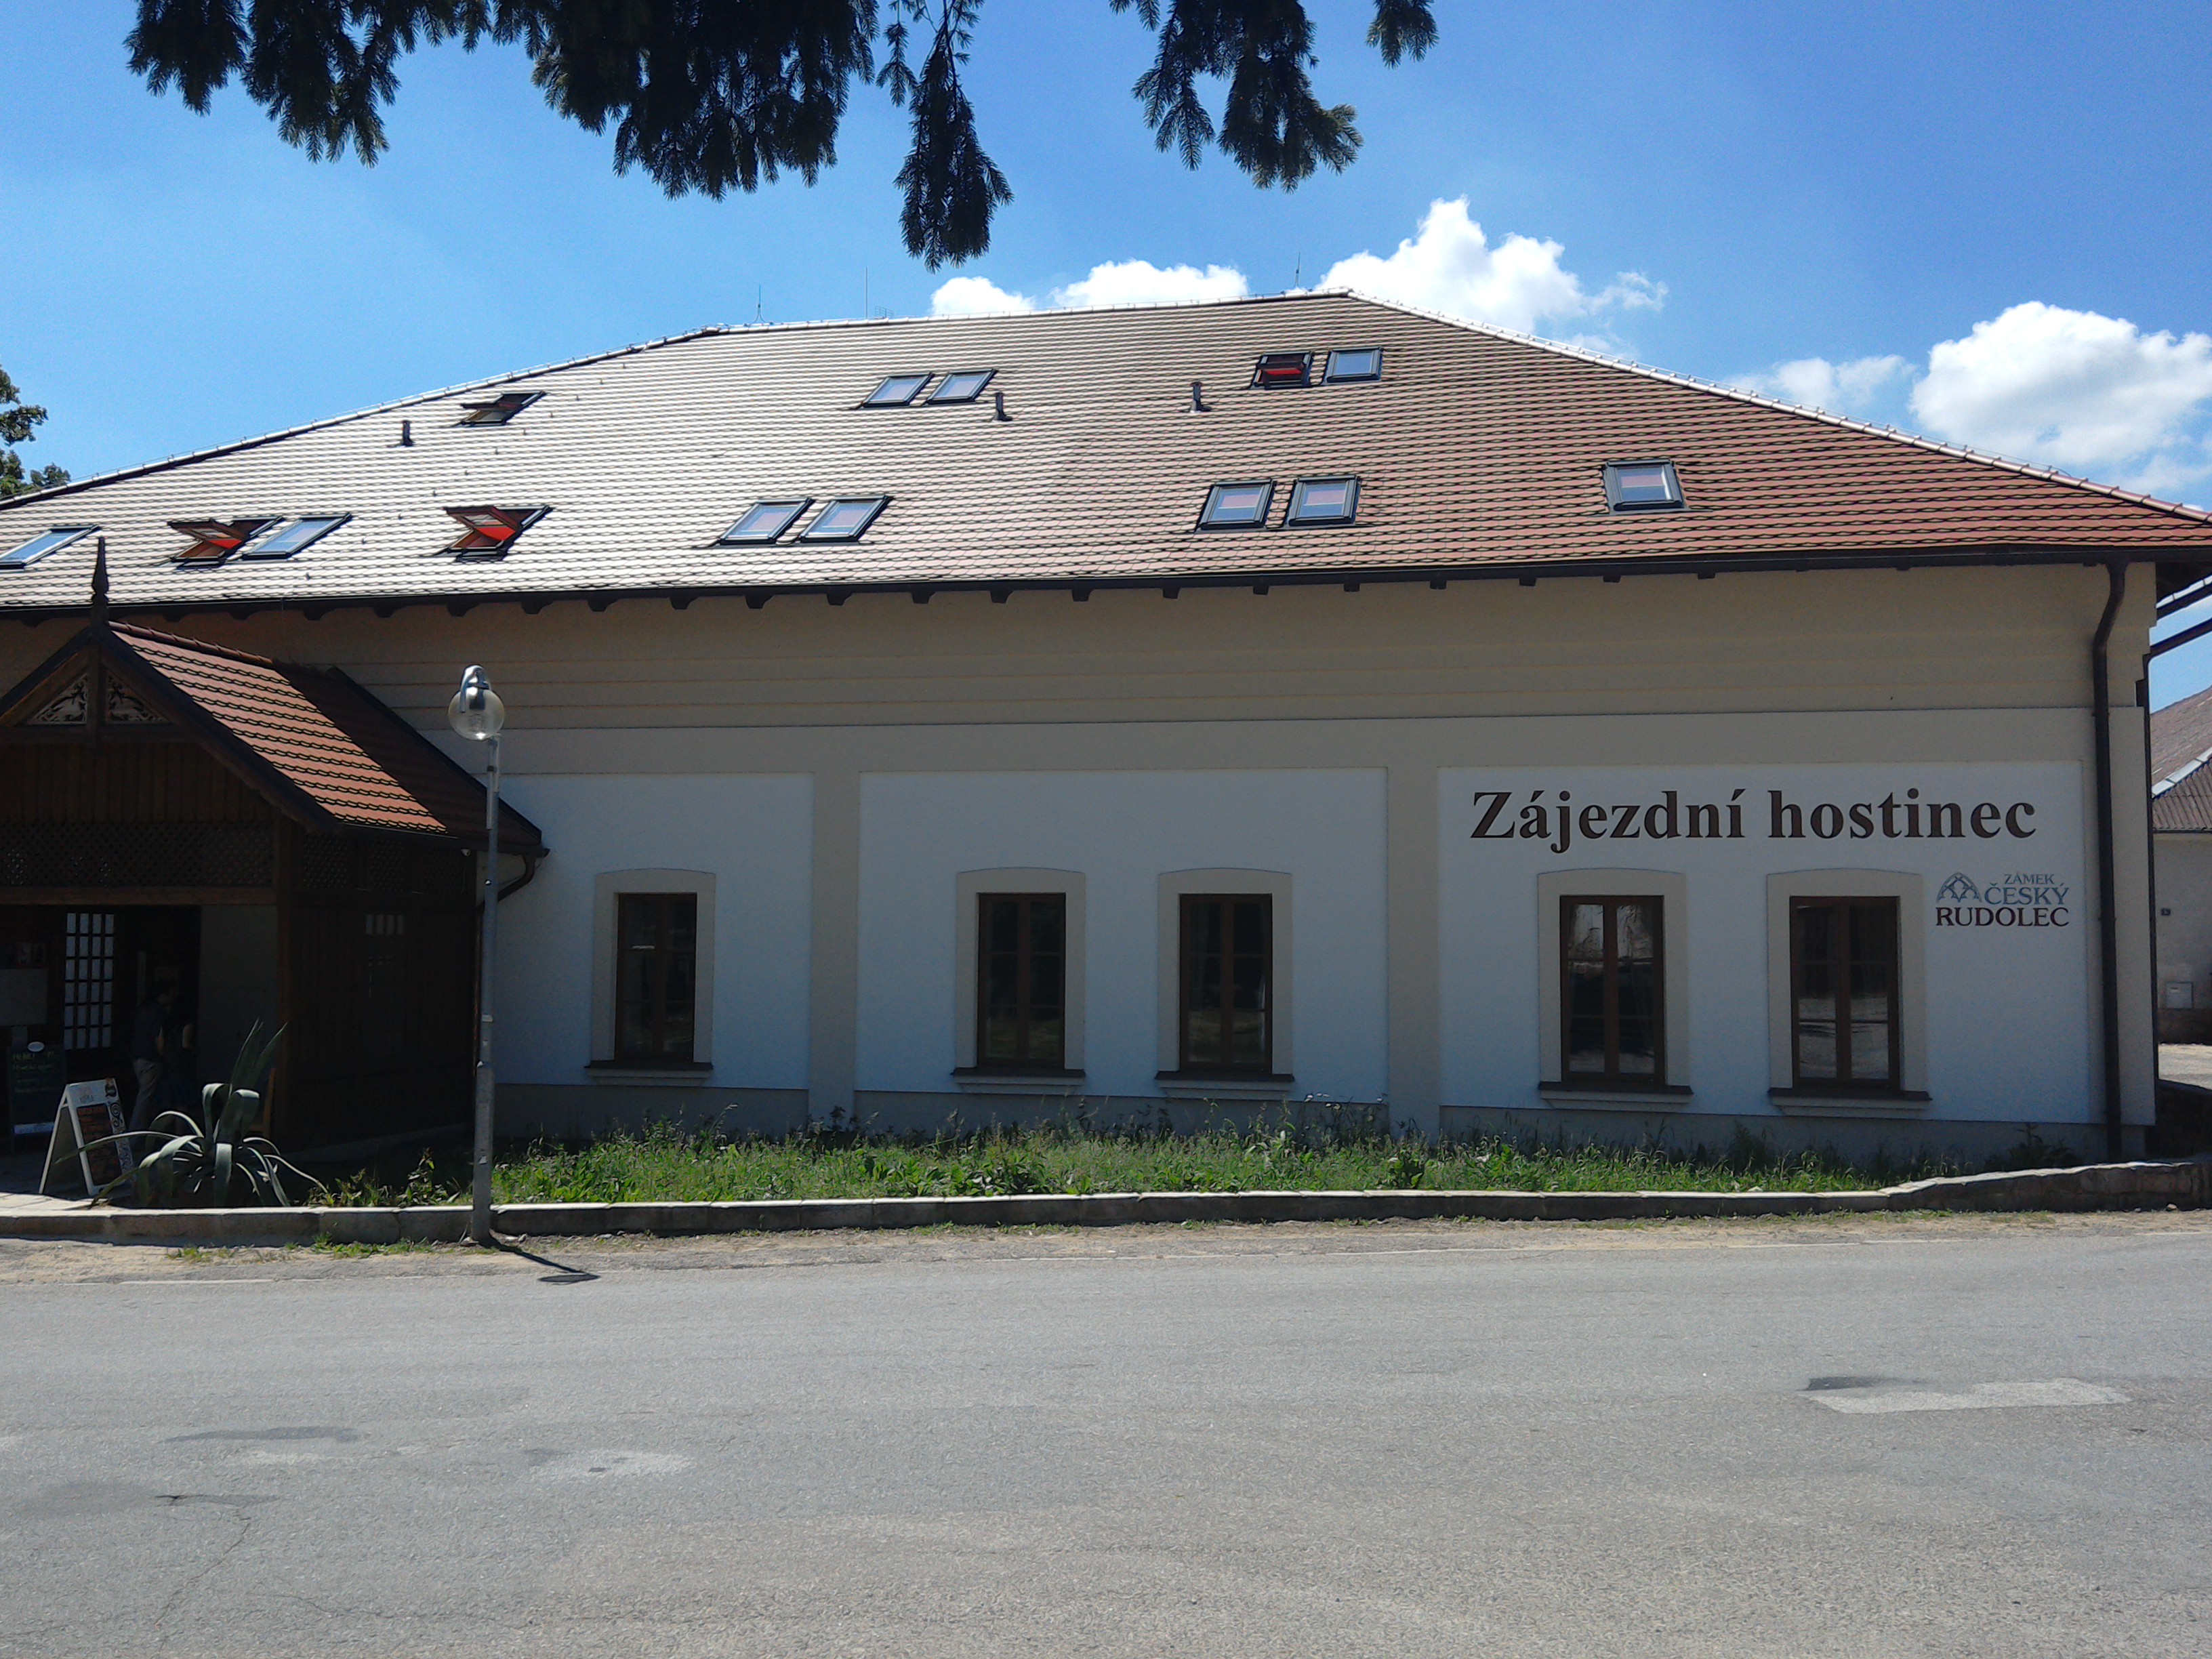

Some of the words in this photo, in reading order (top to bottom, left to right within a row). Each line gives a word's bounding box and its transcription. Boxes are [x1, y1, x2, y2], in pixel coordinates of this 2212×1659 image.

[1471, 789, 1746, 854] Zájezdní
[1767, 788, 2036, 839] hostinec
[2004, 872, 2055, 885] ZÁMEK
[1984, 882, 2069, 905] ČESKÝ
[1936, 907, 2069, 927] RUDOLEC
